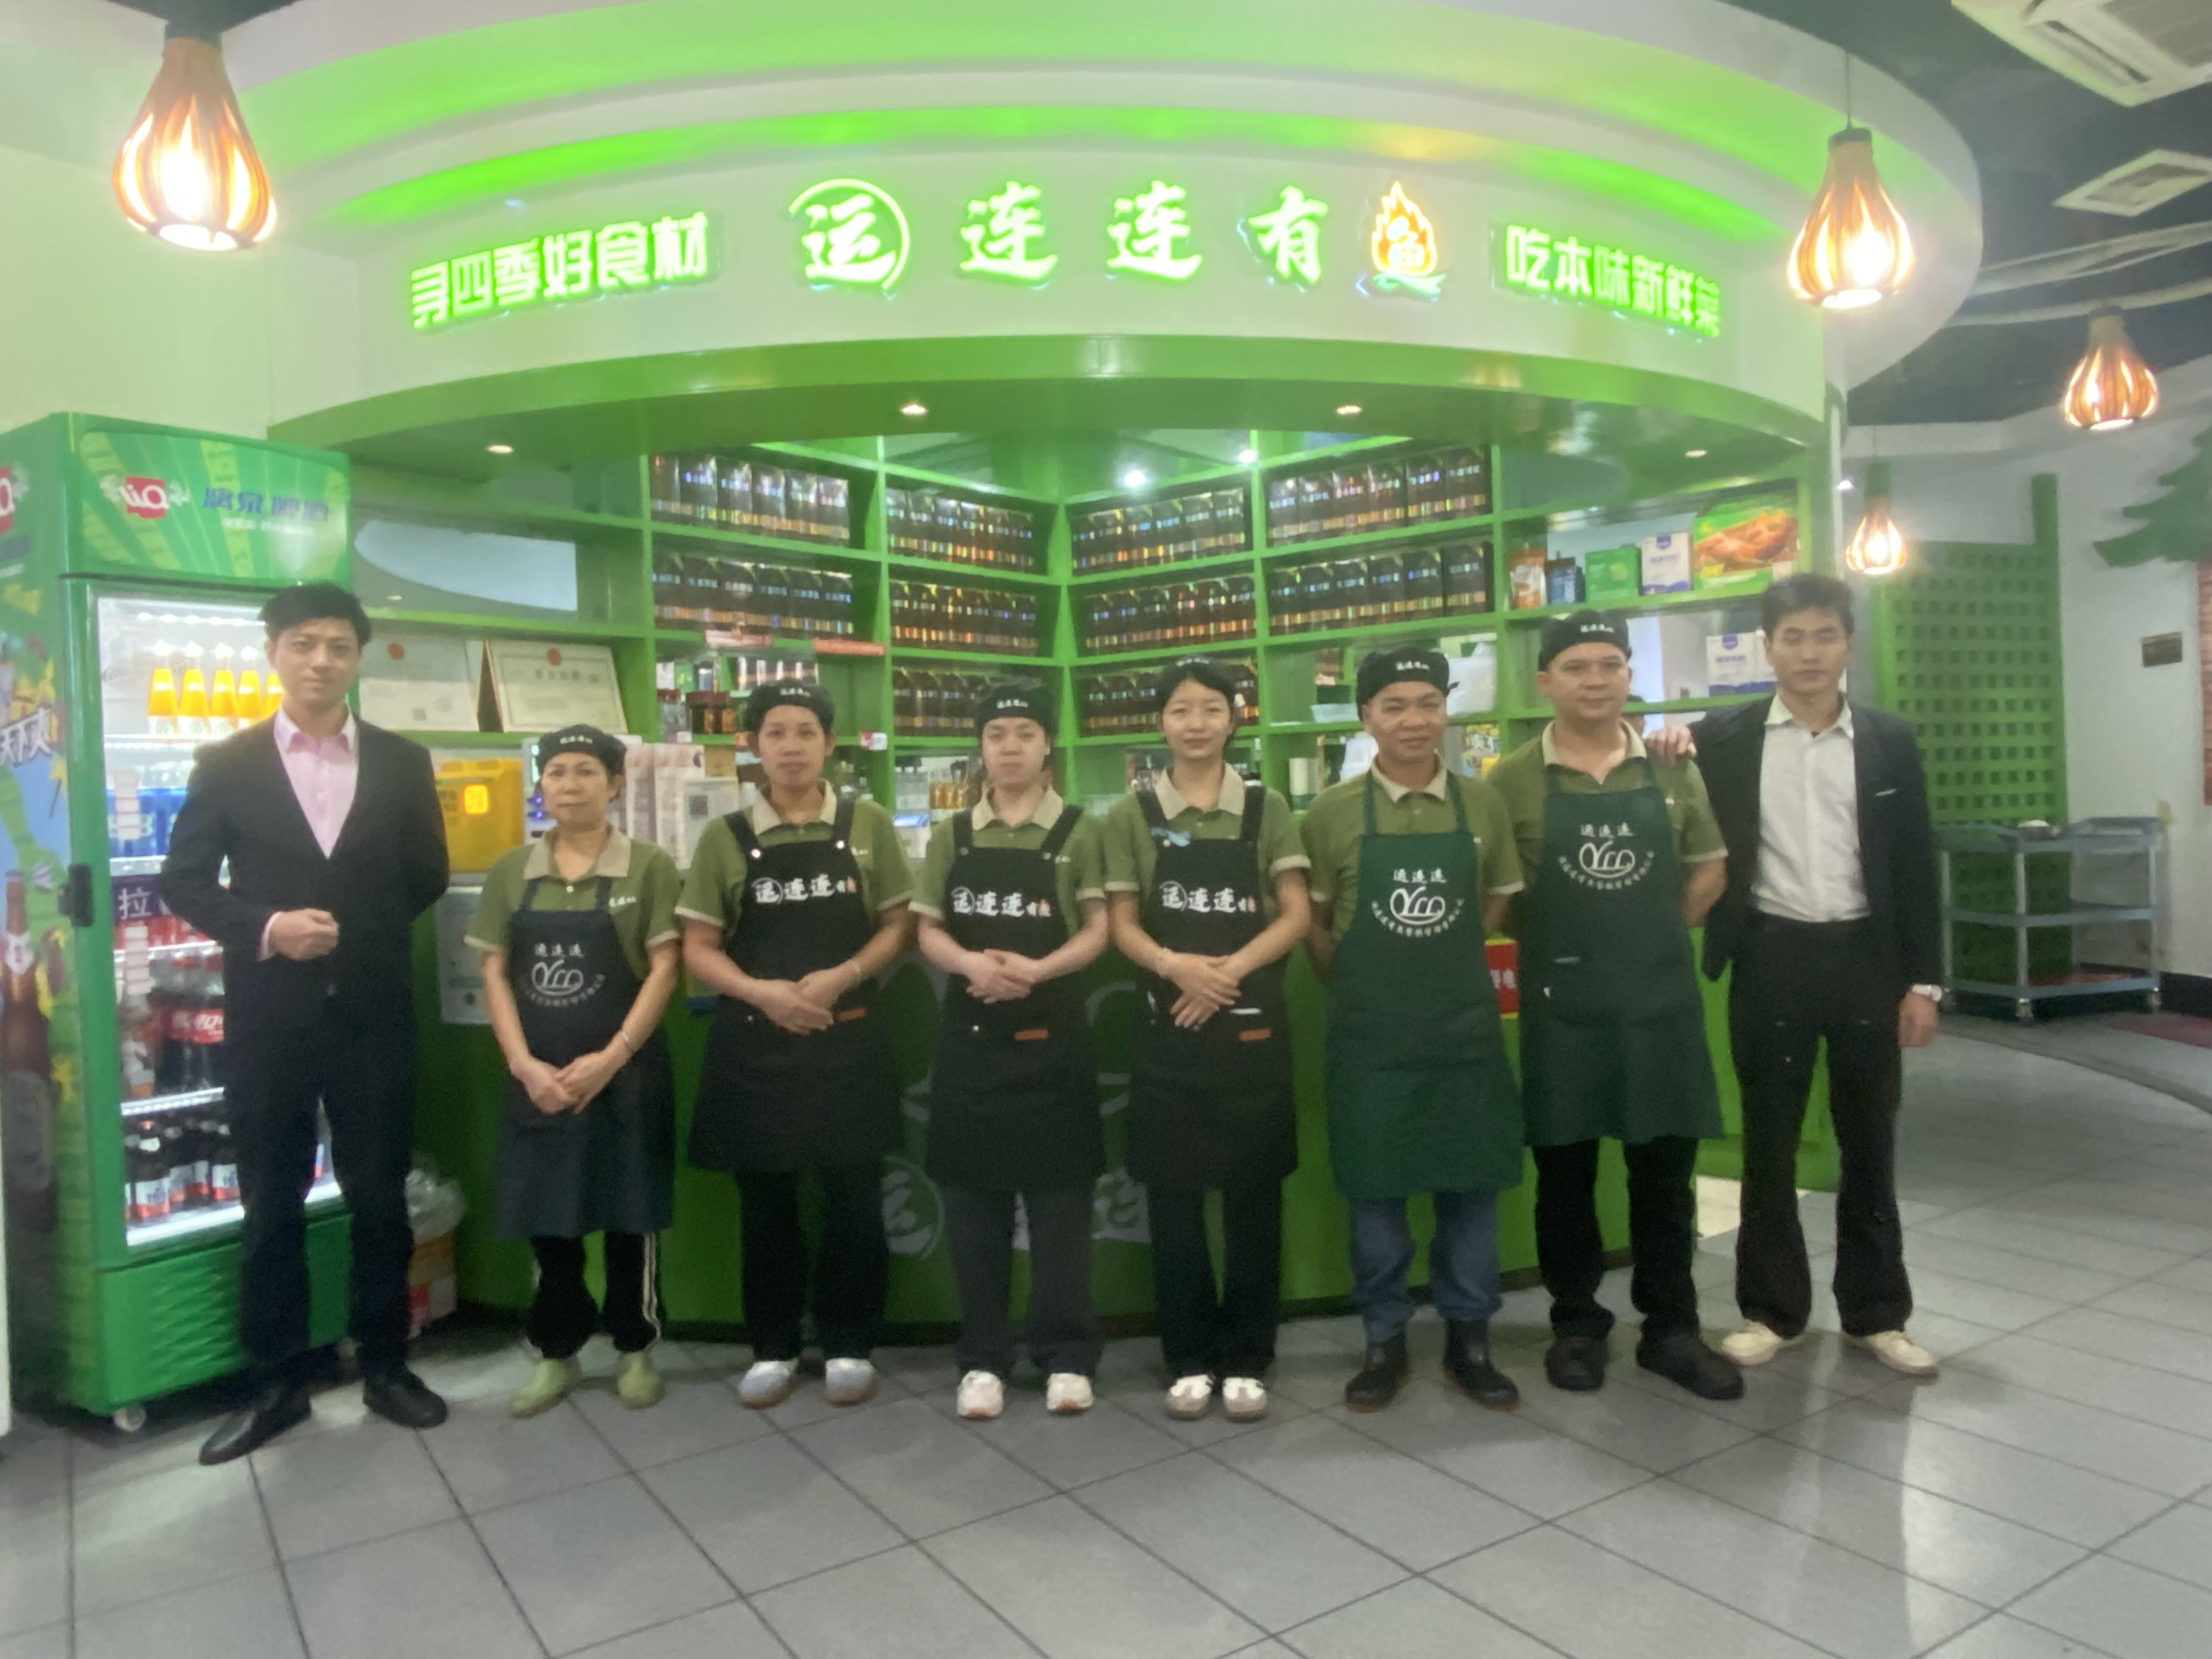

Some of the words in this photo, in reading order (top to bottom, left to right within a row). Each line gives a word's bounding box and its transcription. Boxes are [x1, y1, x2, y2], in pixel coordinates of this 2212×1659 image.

[410, 211, 709, 331] 寻四季好食材
[1505, 223, 1721, 338] 吃本味新鲜菜
[117, 888, 153, 921] 拉
